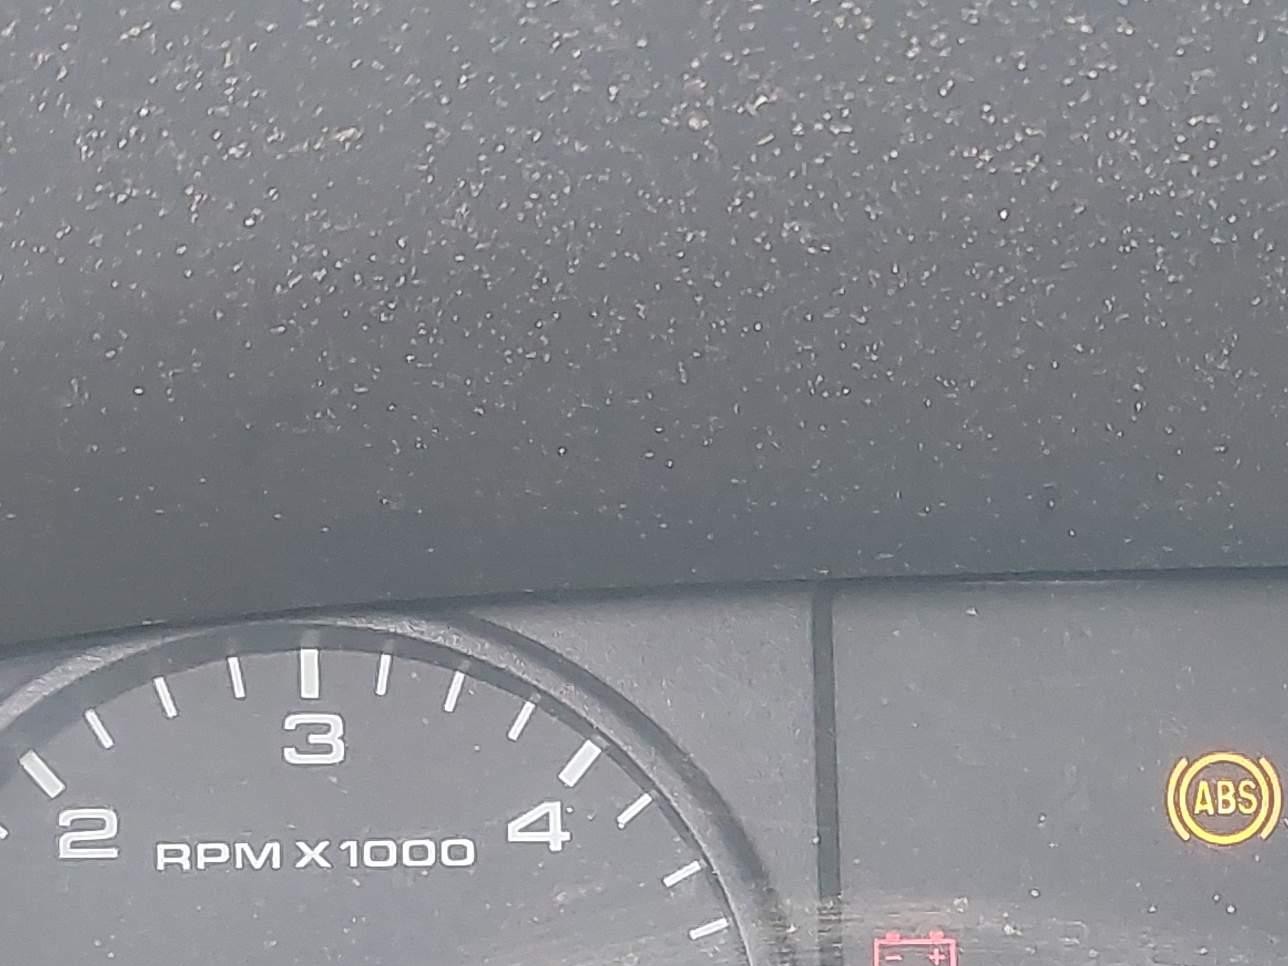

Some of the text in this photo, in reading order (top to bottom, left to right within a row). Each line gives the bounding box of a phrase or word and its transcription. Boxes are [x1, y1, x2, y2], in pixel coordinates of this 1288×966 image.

[283, 713, 345, 765] 3
[1193, 780, 1258, 815] ABS
[57, 808, 119, 859] 2
[507, 801, 571, 852] 4
[155, 840, 281, 871] RPM
